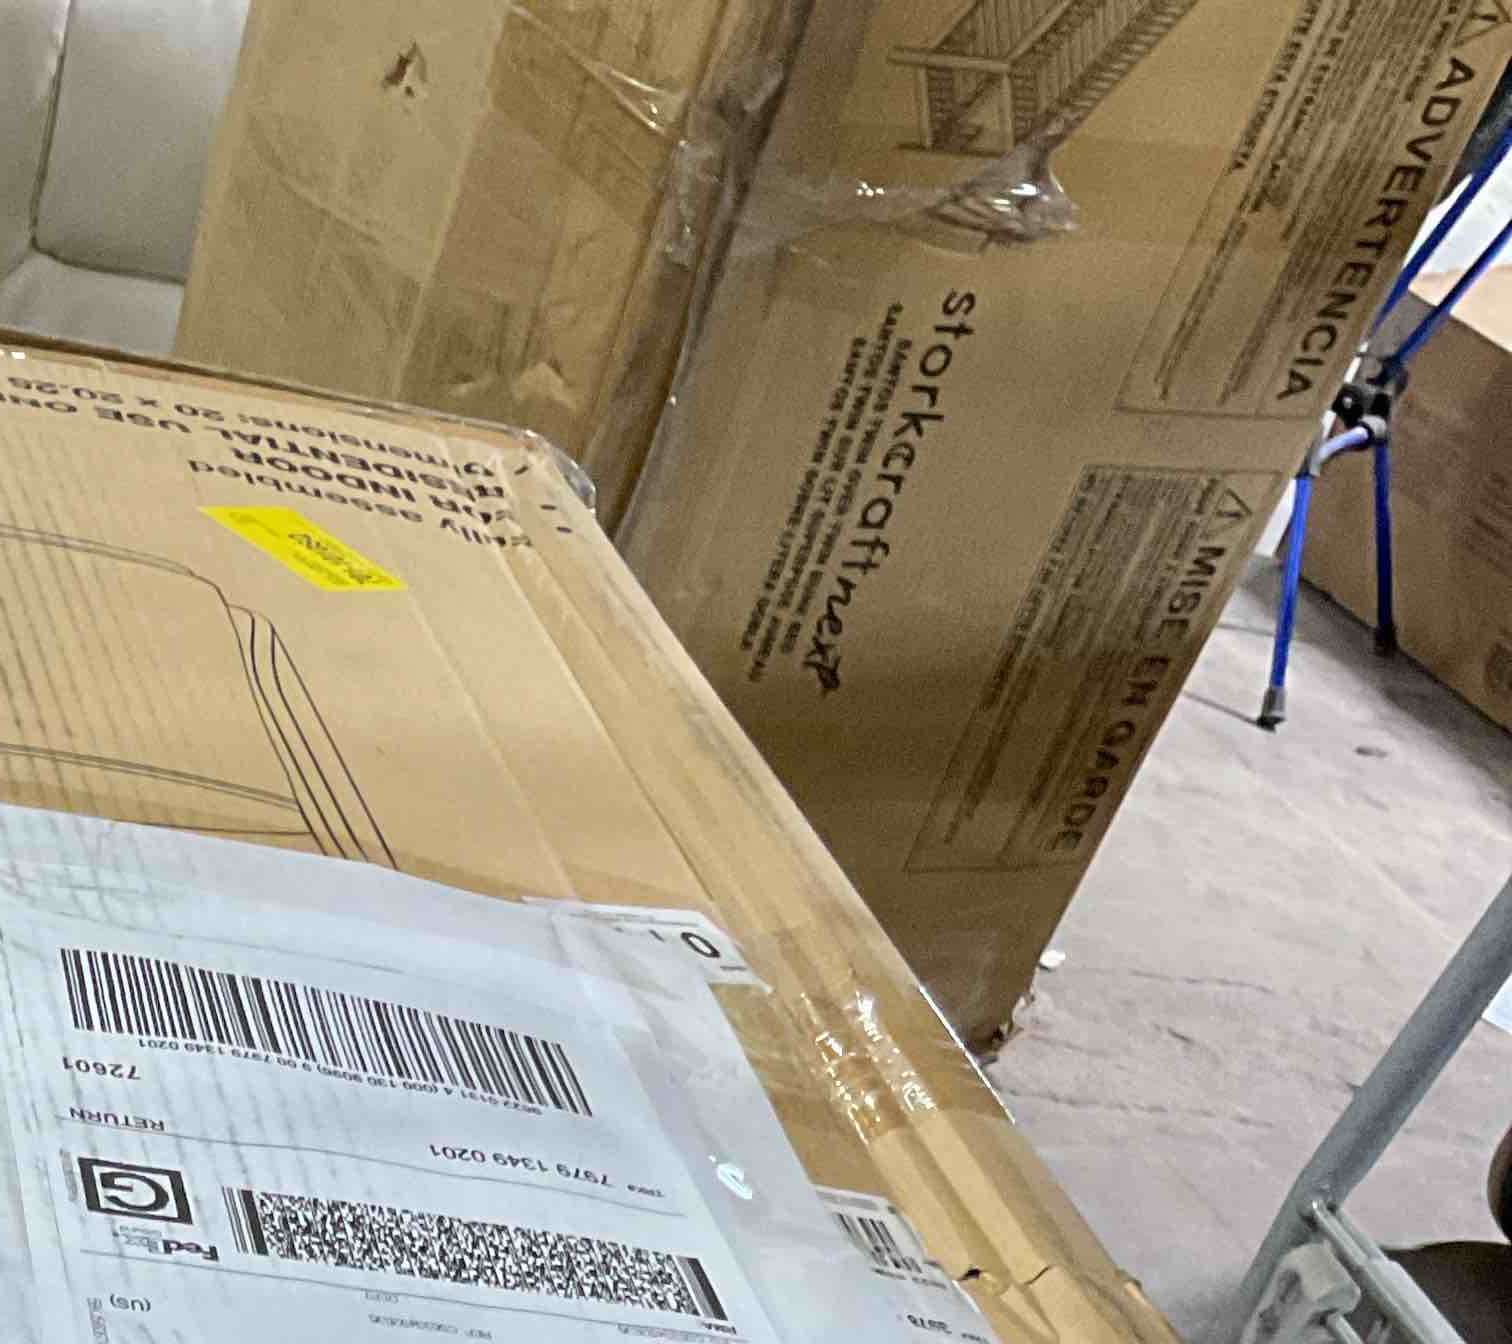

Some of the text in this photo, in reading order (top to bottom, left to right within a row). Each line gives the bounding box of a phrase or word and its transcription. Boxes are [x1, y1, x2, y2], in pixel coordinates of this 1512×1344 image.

[1277, 54, 1477, 401] ADVERTENCIA
[93, 405, 190, 433] USE
[232, 451, 414, 504] INDOOR
[187, 460, 422, 525] assembled
[1047, 542, 1225, 853] MISE EN GARDE
[138, 1041, 179, 1054] 0201
[184, 1045, 224, 1057] 1349
[60, 1056, 141, 1080] 72601
[69, 1108, 165, 1131] RETURN
[430, 1145, 487, 1165] 0201
[492, 1152, 548, 1175] 1349
[555, 1164, 609, 1187] 7979
[96, 1173, 168, 1212] G
[110, 1293, 151, 1313] (US)
